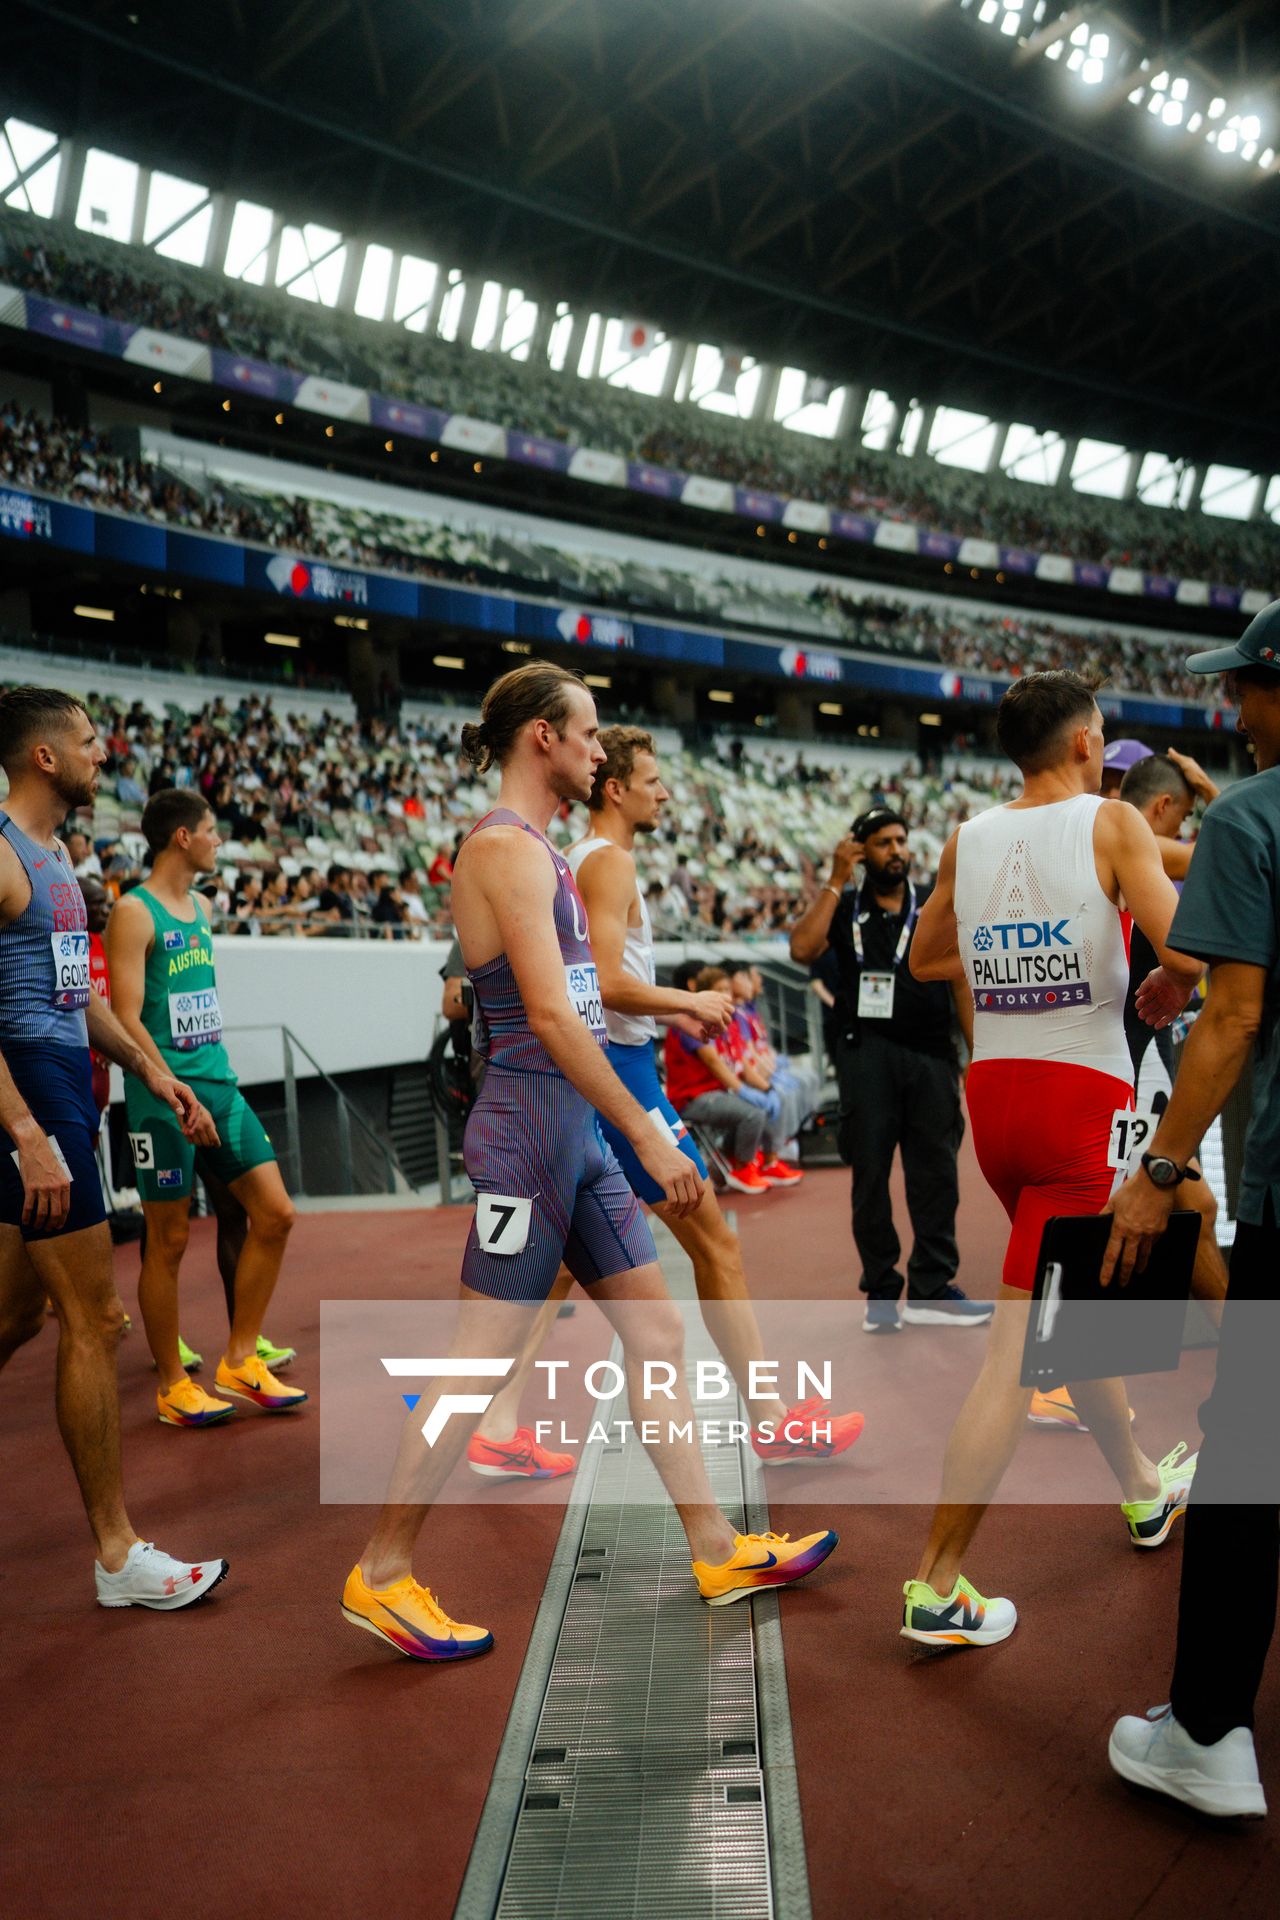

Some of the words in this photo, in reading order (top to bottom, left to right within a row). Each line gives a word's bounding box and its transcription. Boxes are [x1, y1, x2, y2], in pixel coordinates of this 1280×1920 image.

[992, 919, 1073, 950] TDK
[972, 952, 1081, 985] PALLITSCH
[191, 992, 217, 1010] TDK
[176, 1010, 221, 1033] MYERS
[487, 1203, 517, 1245] 7
